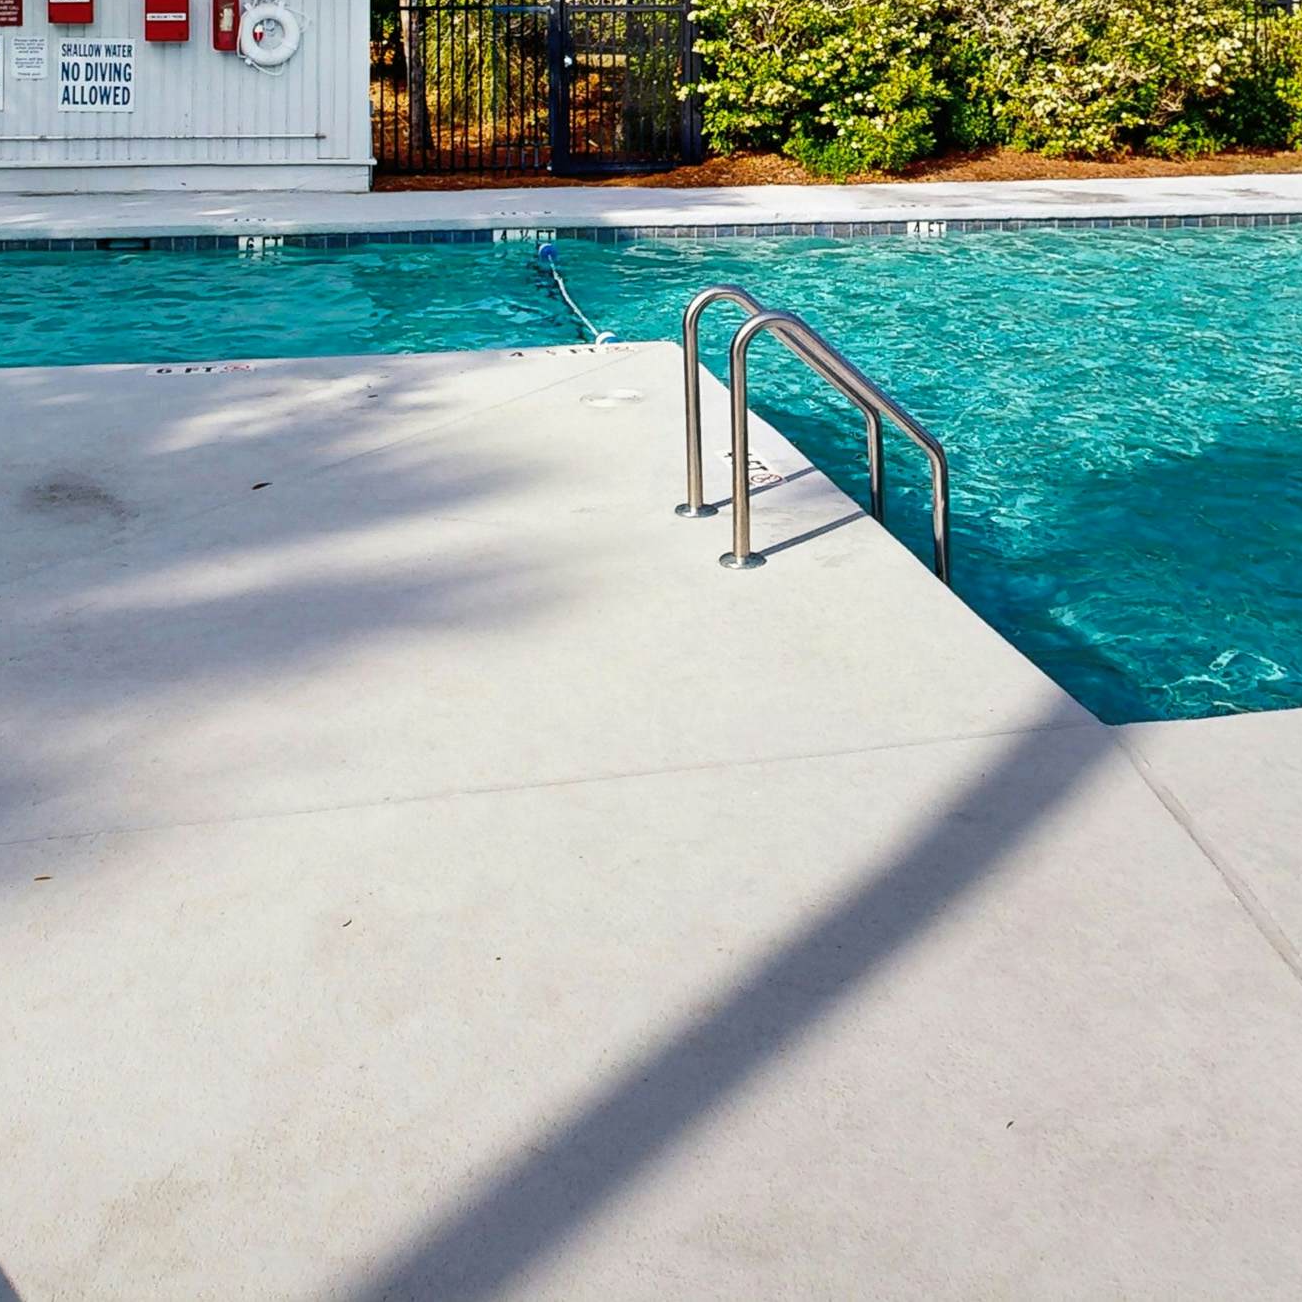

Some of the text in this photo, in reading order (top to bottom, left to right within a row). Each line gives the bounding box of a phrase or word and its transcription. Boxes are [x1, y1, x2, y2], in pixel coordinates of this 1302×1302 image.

[61, 43, 103, 57] SHALLOW
[105, 44, 133, 58] WATER
[61, 61, 80, 82] NO
[85, 62, 132, 82] DIVING
[61, 85, 131, 106] ALLOWED
[928, 221, 944, 239] FT
[246, 237, 254, 251] 6
[184, 365, 217, 374] FT
